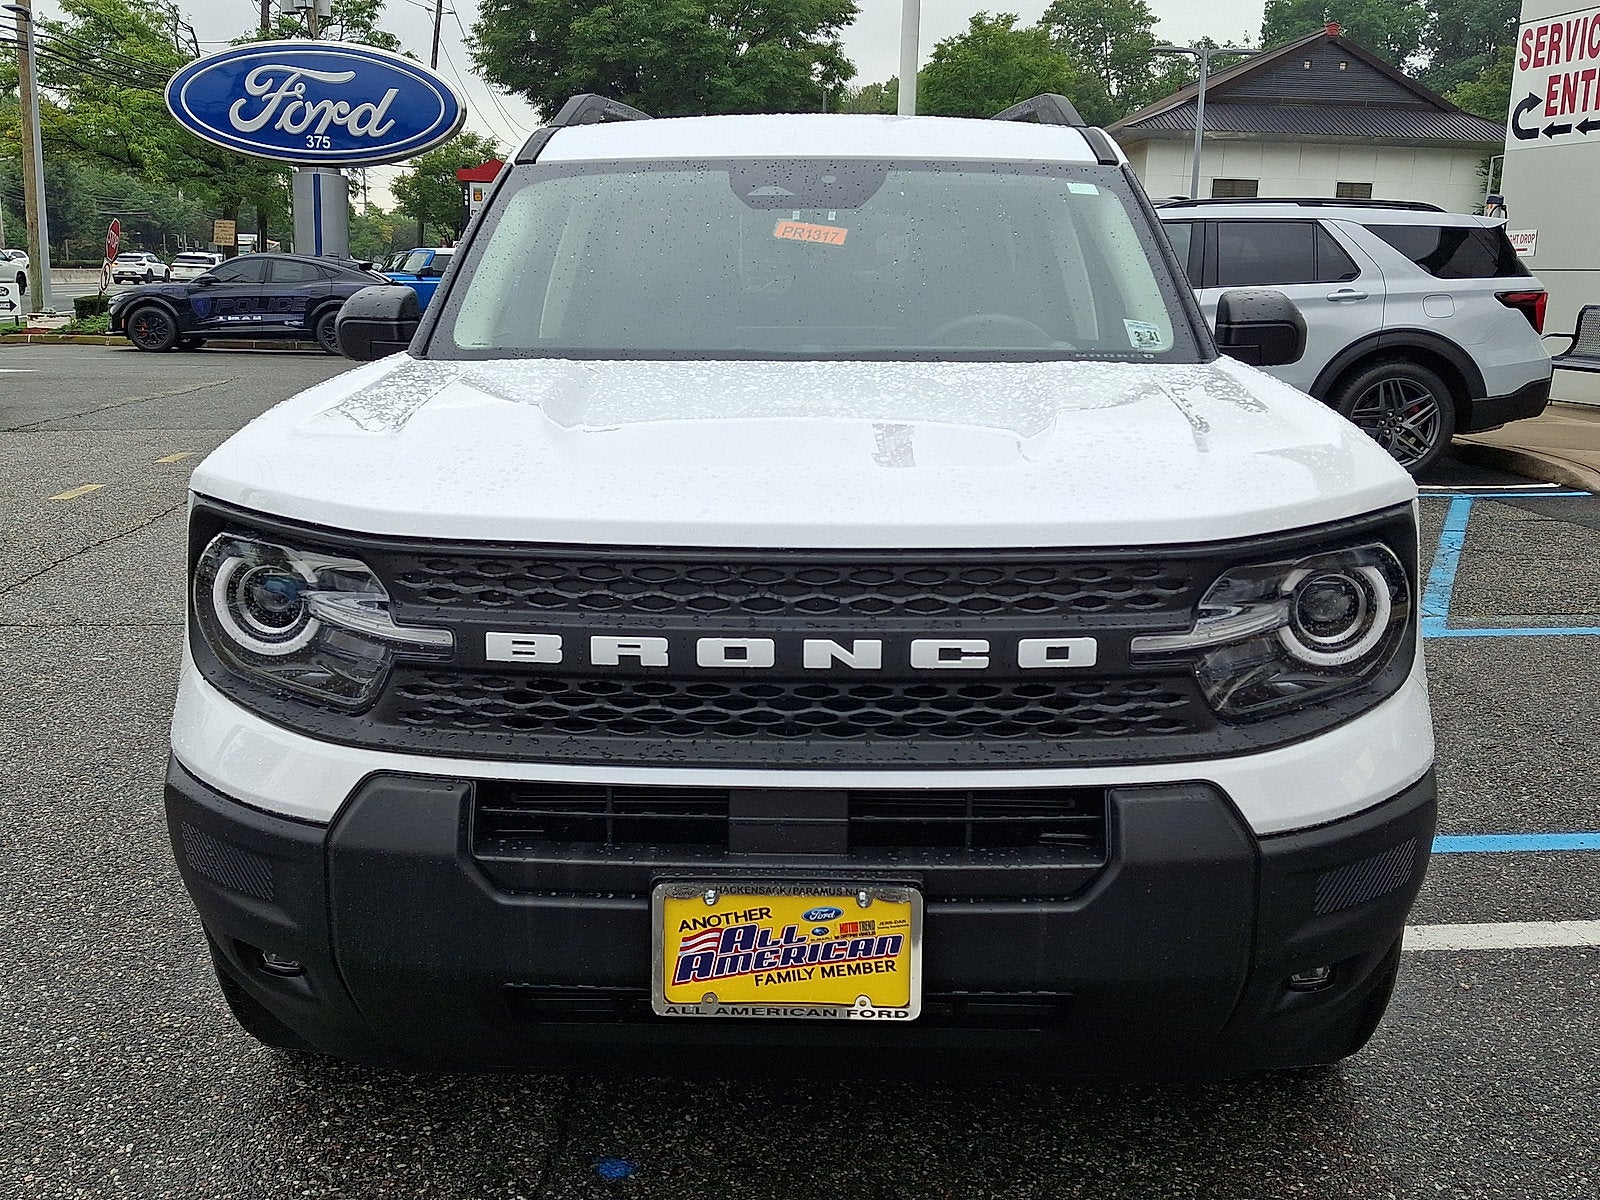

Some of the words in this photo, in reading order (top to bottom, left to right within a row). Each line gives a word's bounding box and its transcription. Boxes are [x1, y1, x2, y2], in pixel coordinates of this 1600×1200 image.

[229, 64, 400, 137] Ford
[1544, 68, 1600, 117] ENT
[306, 135, 331, 149] 375
[782, 226, 839, 242] PR1317
[1520, 233, 1535, 244] DROP
[215, 297, 310, 313] POLICE
[485, 631, 1098, 670] BRONCO
[678, 907, 773, 933] ANOTHER
[809, 908, 835, 921] Ford
[840, 922, 859, 934] MOTOR
[719, 924, 808, 955] ALL
[674, 935, 905, 984] AMERICAN
[755, 967, 815, 986] FAMILY
[821, 959, 897, 979] MEMBER
[664, 1006, 707, 1015] ALL
[715, 1007, 837, 1017] AMERICAN
[847, 1009, 909, 1018] FORD
